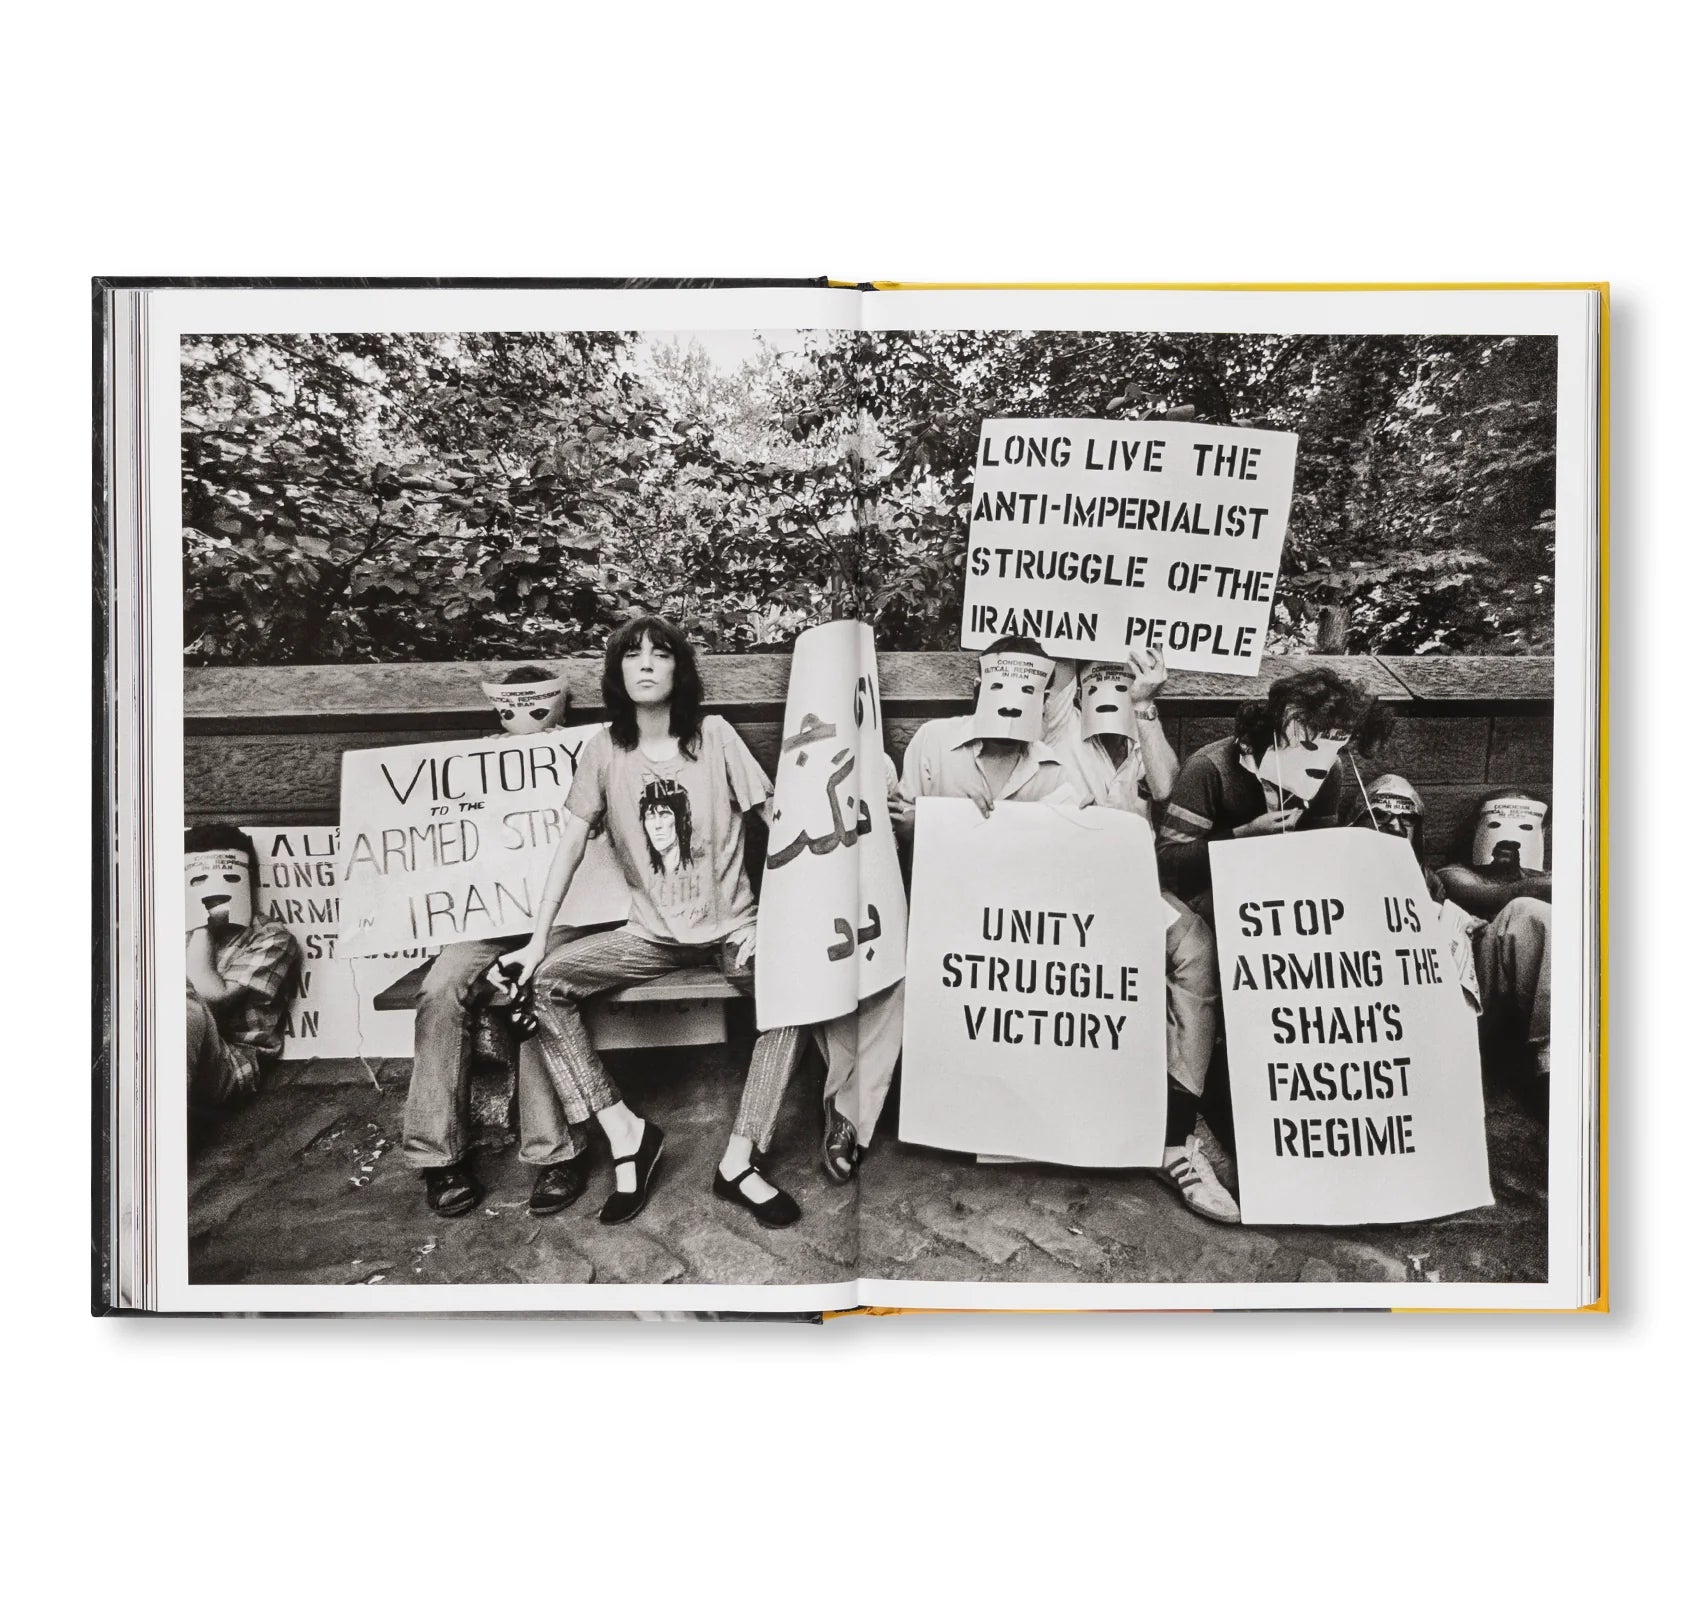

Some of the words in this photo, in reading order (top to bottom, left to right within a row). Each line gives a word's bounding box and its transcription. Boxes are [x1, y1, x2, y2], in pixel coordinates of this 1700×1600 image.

[982, 435, 1071, 467] LONG
[1085, 439, 1166, 472] LIVE
[1193, 444, 1262, 480] THE
[973, 491, 1268, 540] ANTI-IMPERIALIST
[971, 547, 1148, 588] STRUGGLE
[971, 605, 1098, 642] IRANIAN
[1125, 616, 1257, 657] PEOPLE
[381, 741, 583, 805] VICTORY
[431, 806, 449, 816] TO
[459, 801, 486, 812] THE
[344, 819, 479, 881] ARMED
[409, 878, 534, 939] IRAN
[983, 907, 1095, 947] UNITY
[1239, 898, 1345, 936] STOP
[942, 953, 1138, 1001] STRUGGLE
[1232, 950, 1383, 991] ARMING
[1395, 948, 1443, 985] THE
[964, 1005, 1127, 1050] VICTORY
[1271, 1001, 1403, 1044] SHAH'S
[1267, 1057, 1411, 1101] FASCIST
[1273, 1115, 1416, 1158] REGIME
